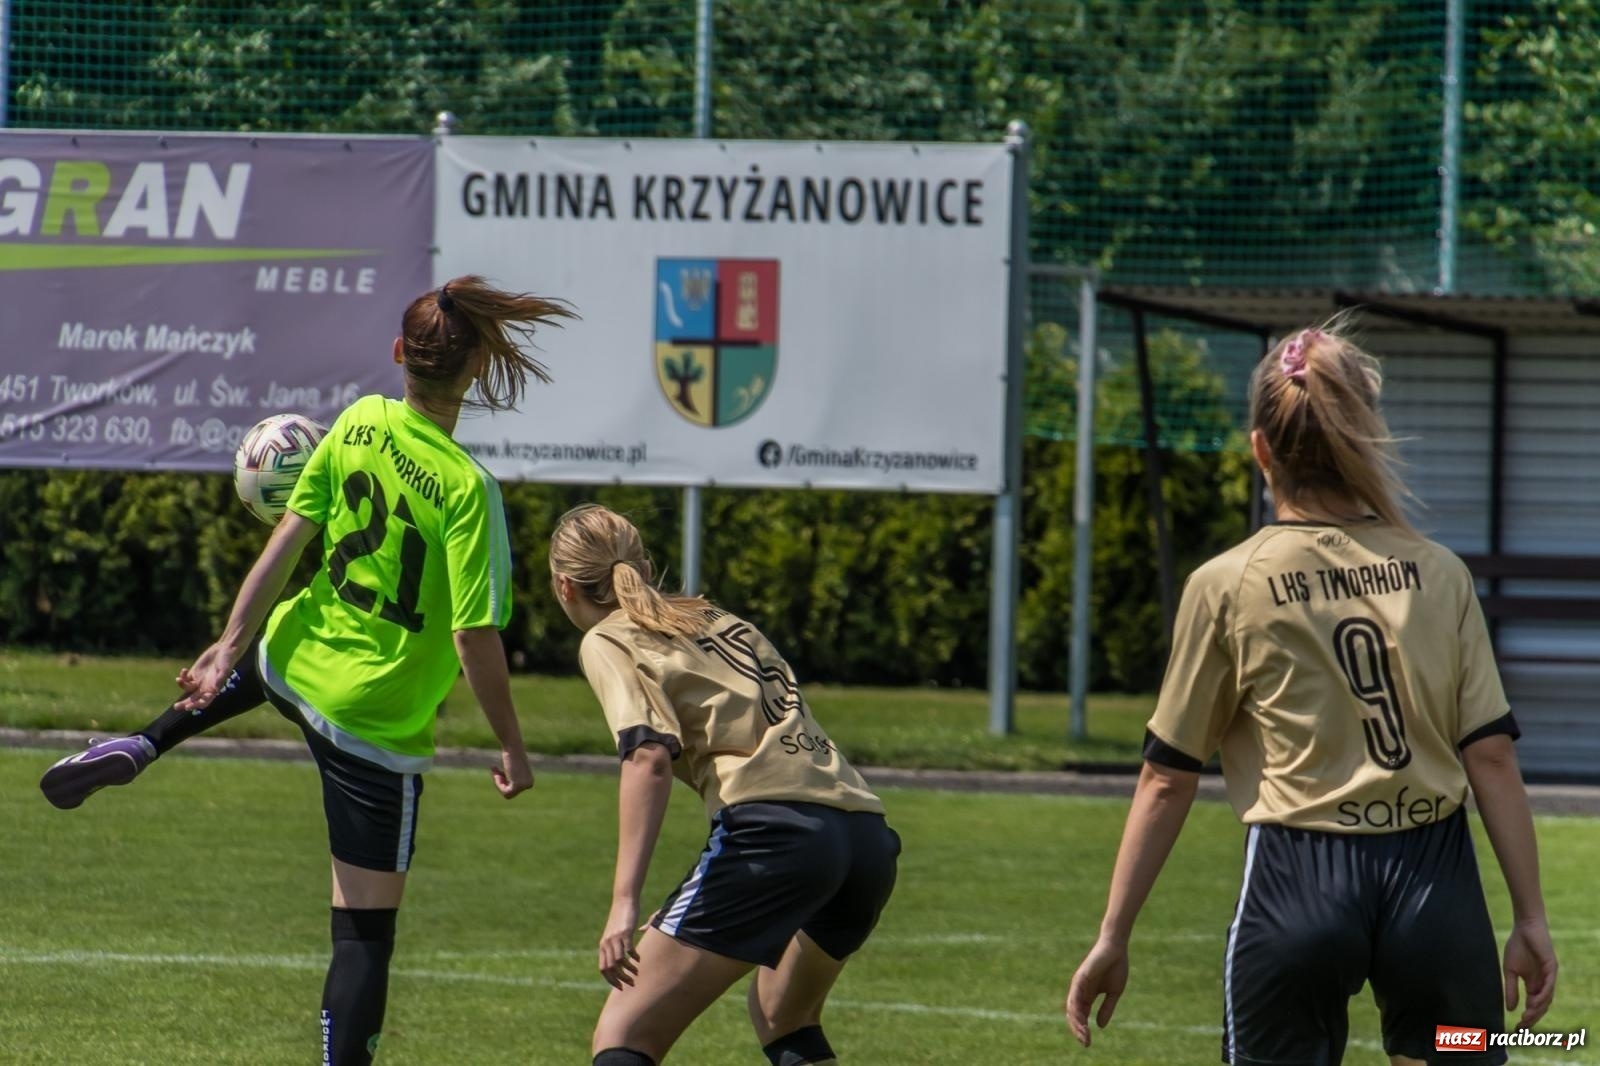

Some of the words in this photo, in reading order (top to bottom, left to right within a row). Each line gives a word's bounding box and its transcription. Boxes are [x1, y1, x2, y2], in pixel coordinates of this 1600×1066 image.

[0, 158, 251, 240] GRAN
[462, 172, 616, 220] GMINA
[632, 164, 985, 226] KRZYŻANOWICE
[255, 266, 377, 294] MEBLE
[58, 322, 137, 350] Marek
[144, 324, 257, 360] Mańczyk
[52, 414, 98, 443] 323
[104, 416, 153, 446] 630,
[463, 438, 647, 468] ww.krzyzanowice.pl
[328, 469, 427, 633] 21
[1333, 617, 1412, 771] 9
[1337, 786, 1447, 828] safer
